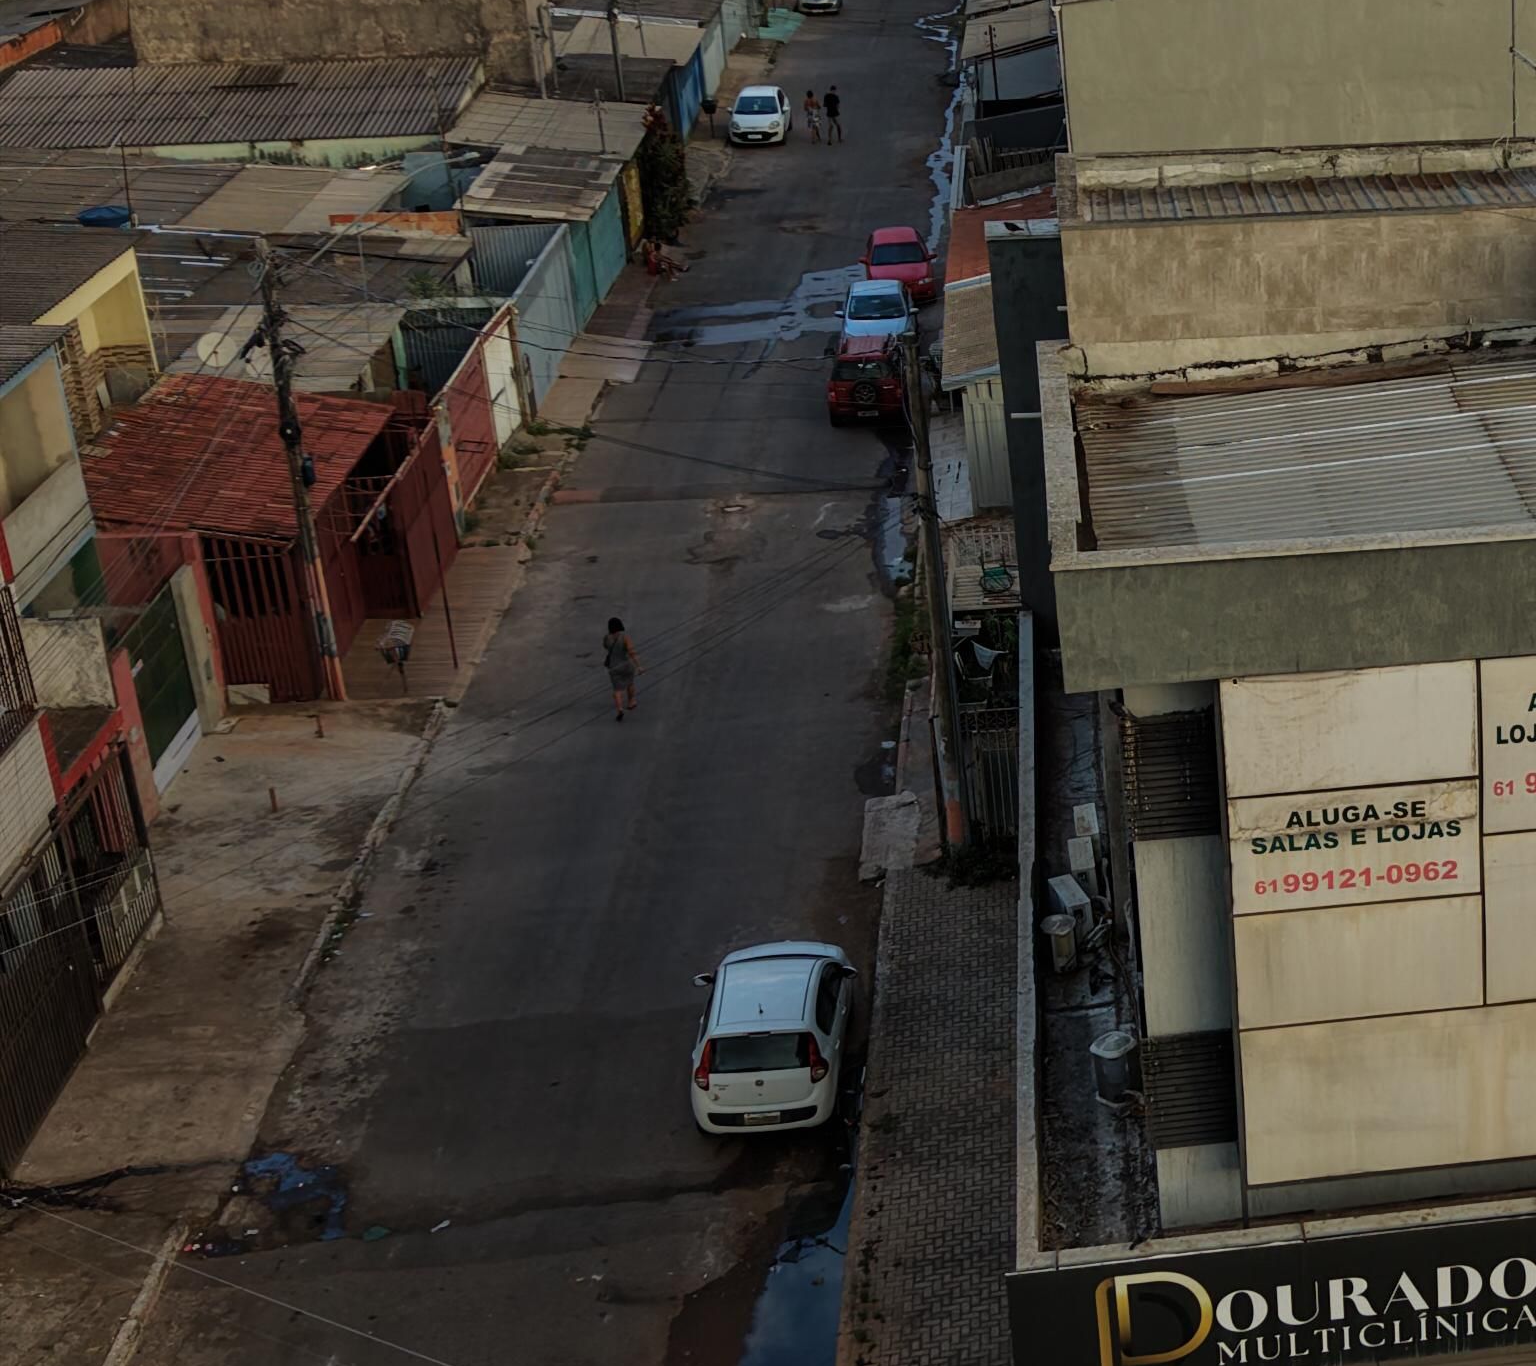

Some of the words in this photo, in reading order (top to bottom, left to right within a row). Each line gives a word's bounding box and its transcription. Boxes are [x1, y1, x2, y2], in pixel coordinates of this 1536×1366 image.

[1492, 780, 1516, 797] 61
[1285, 800, 1427, 829] ALUGA-SE
[1250, 829, 1339, 855] SALAS
[1350, 827, 1367, 846] E
[1376, 816, 1462, 844] LOJAS
[1254, 878, 1279, 897] 61
[1283, 859, 1458, 895] 99121-0962
